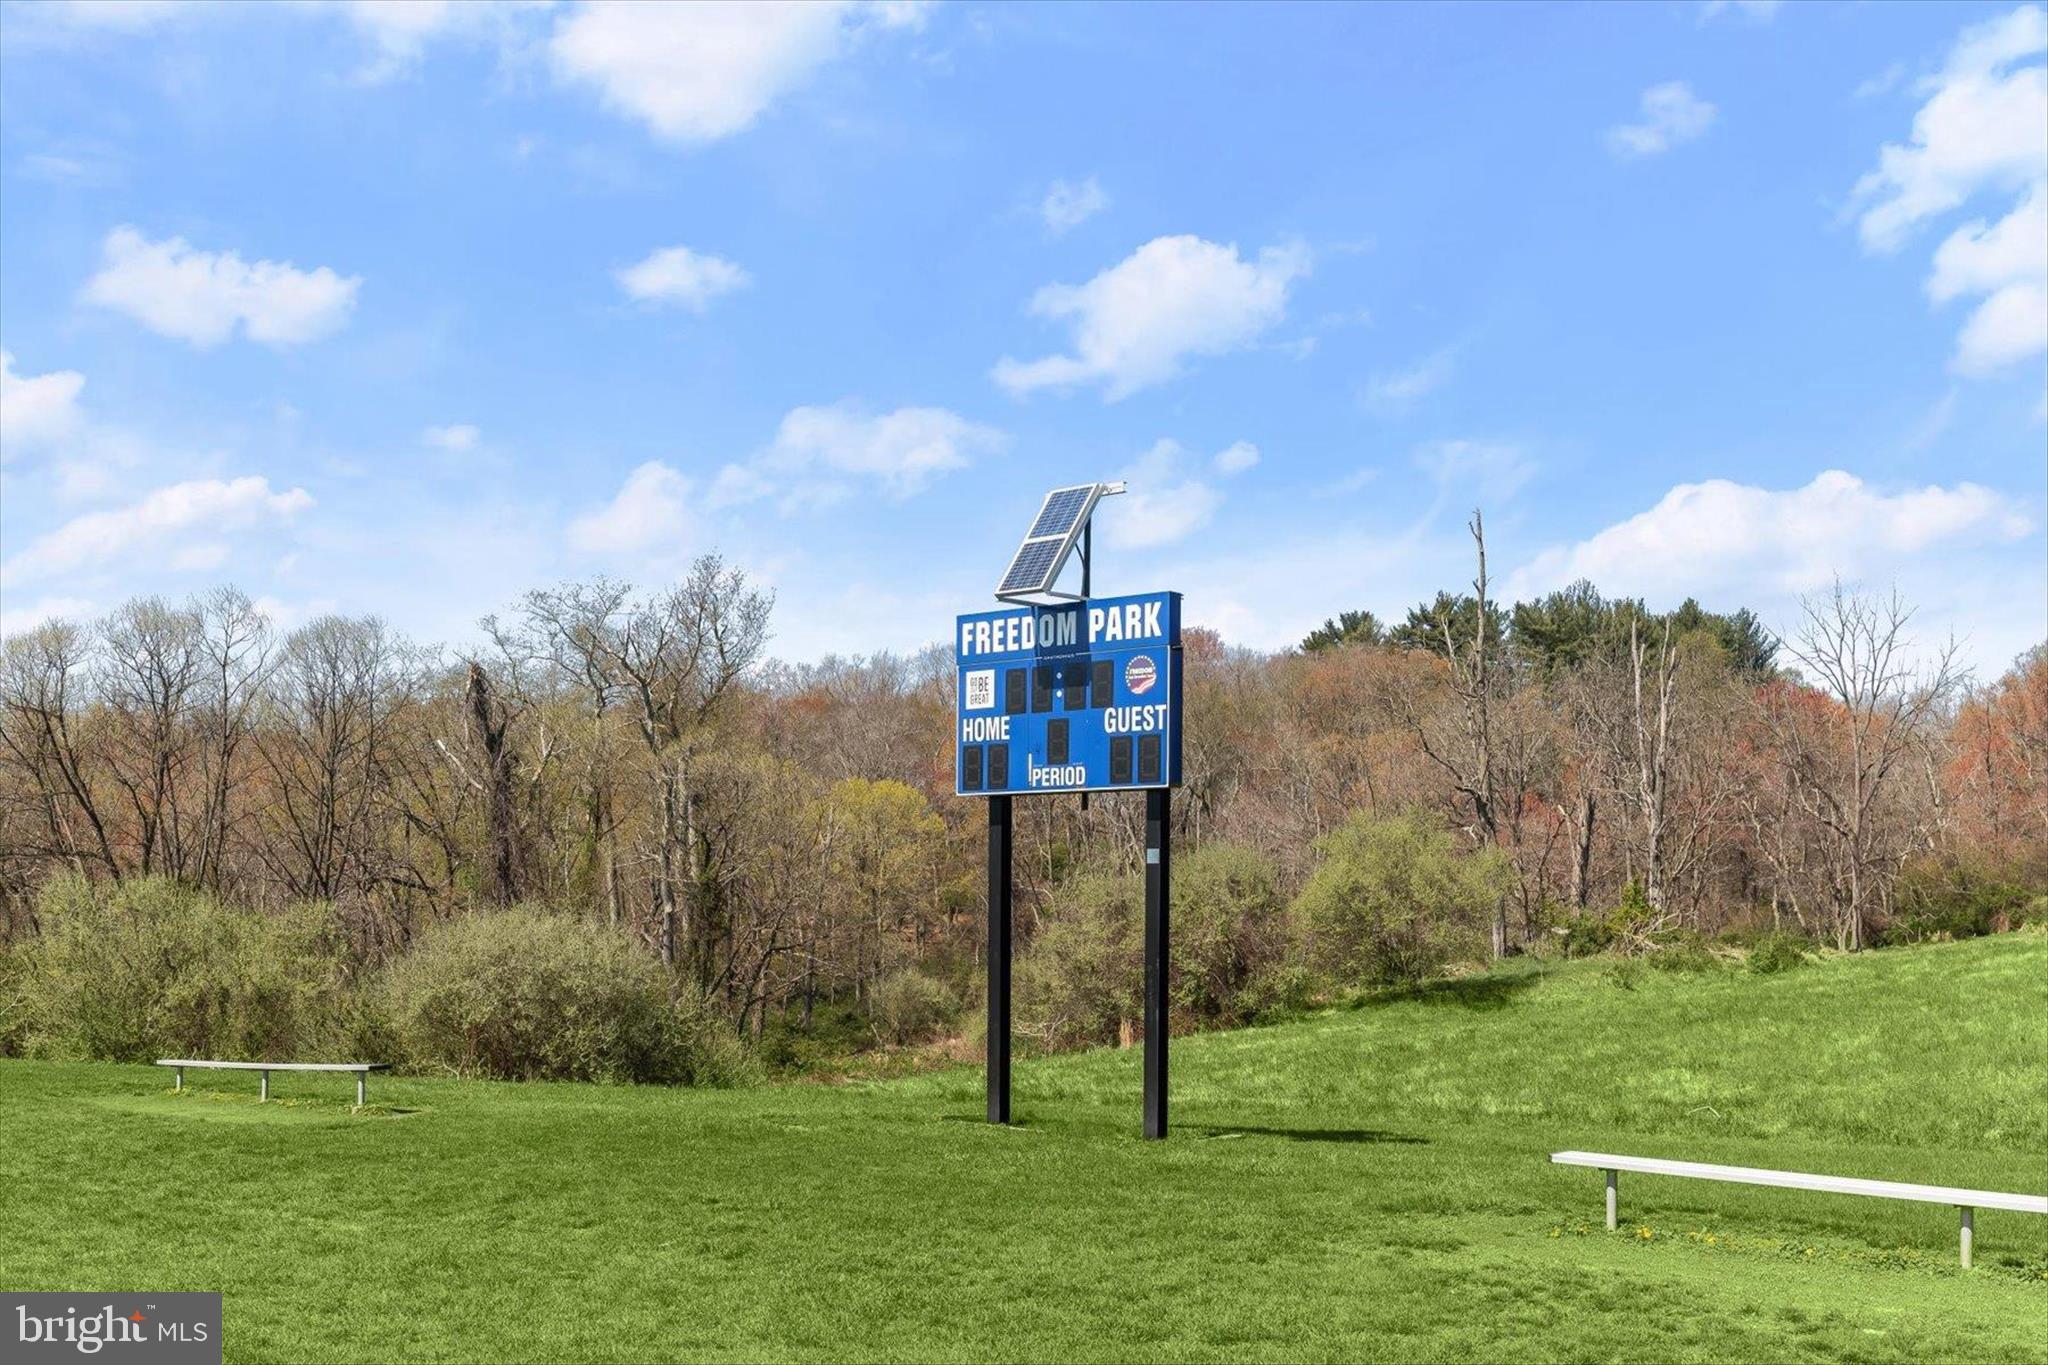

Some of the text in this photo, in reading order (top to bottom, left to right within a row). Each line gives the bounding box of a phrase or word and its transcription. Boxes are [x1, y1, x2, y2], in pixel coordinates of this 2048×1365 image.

[961, 601, 1162, 656] FREEDOM PARK
[963, 715, 1011, 742] HOME
[1104, 704, 1167, 734] GUEST
[1032, 766, 1086, 787] PERIOD
